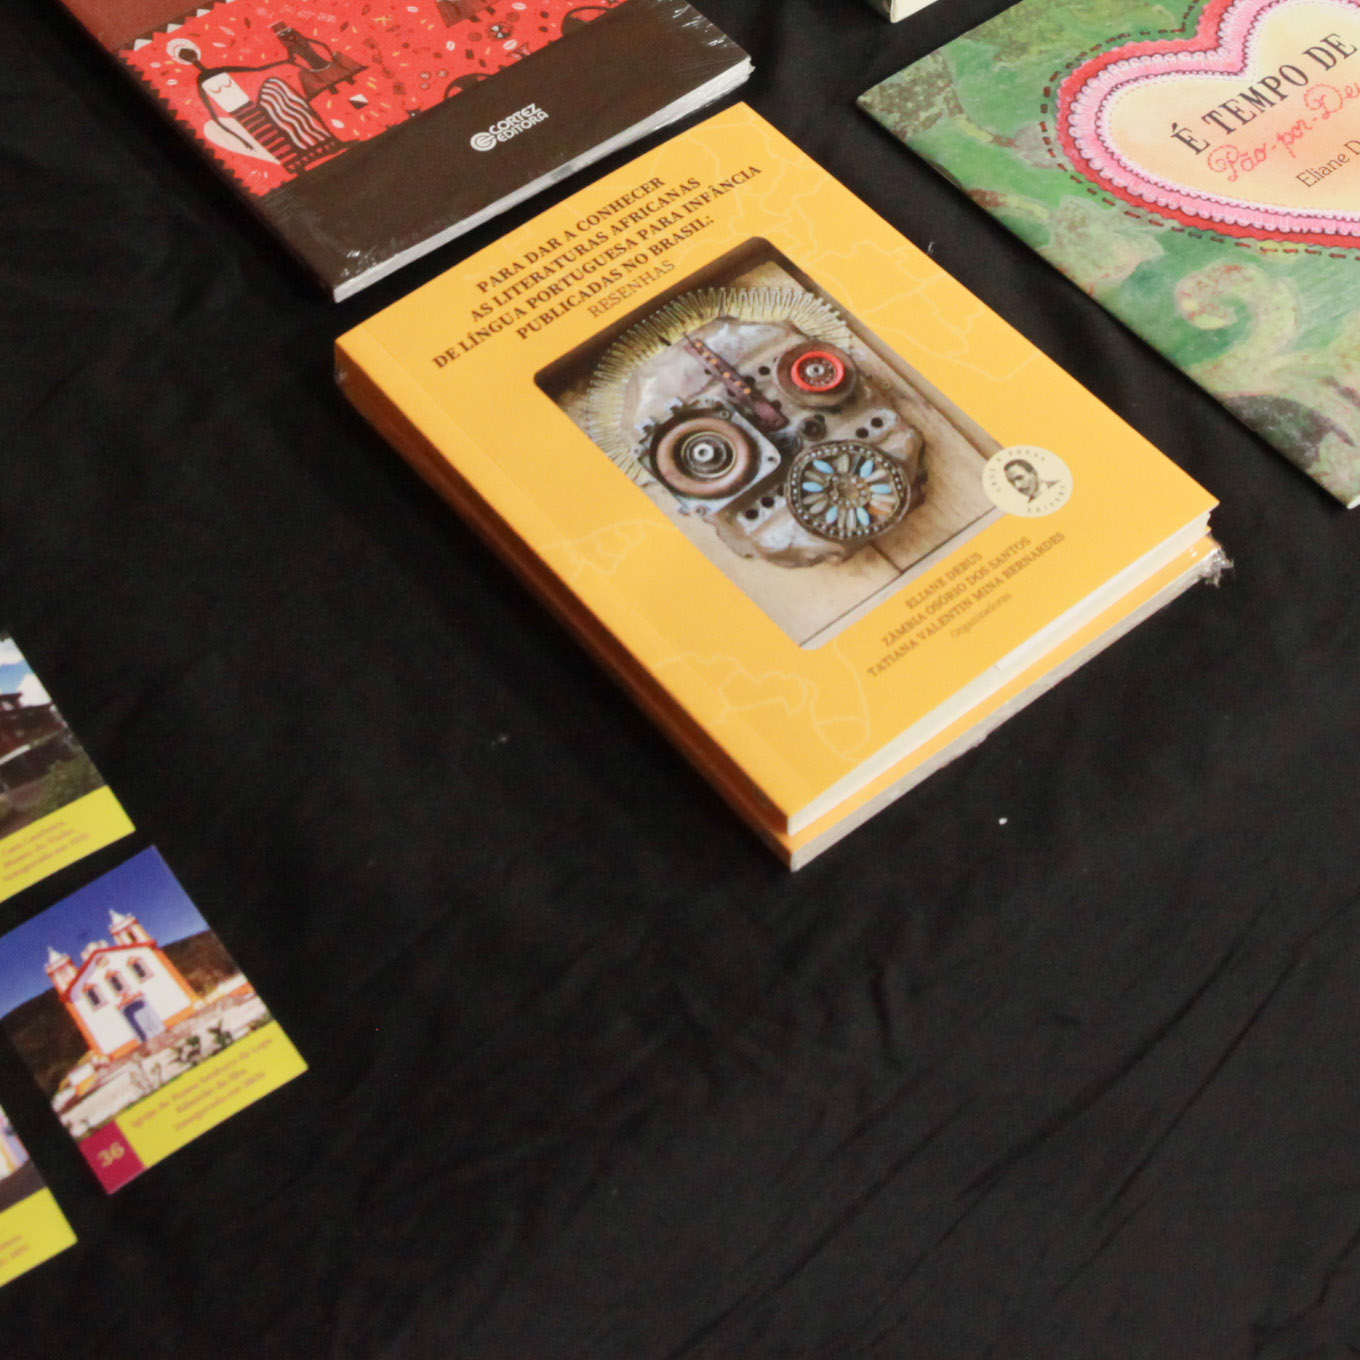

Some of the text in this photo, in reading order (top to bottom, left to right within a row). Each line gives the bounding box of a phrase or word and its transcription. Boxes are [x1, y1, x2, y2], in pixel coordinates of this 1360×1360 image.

[489, 102, 541, 135] CORTEZ
[1170, 33, 1358, 155] É TEMPO DE
[496, 111, 549, 142] EDITORA
[1295, 153, 1350, 188] Eliane
[470, 176, 702, 323] AS LITERATURAS AFRICANAS
[475, 176, 666, 294] PARA DAR A CONHECER
[431, 164, 762, 369] DE LÍNGUA PORTUGUESA PARA INFÂNCIA
[515, 215, 716, 341] PUBLICADAS NO BRASIL:
[588, 259, 676, 319] RESENHAS
[905, 551, 984, 610] ELIANE DEBUS
[987, 536, 1032, 569] SANTOS
[867, 639, 920, 678] TATIANA
[97, 1142, 125, 1168] 36
